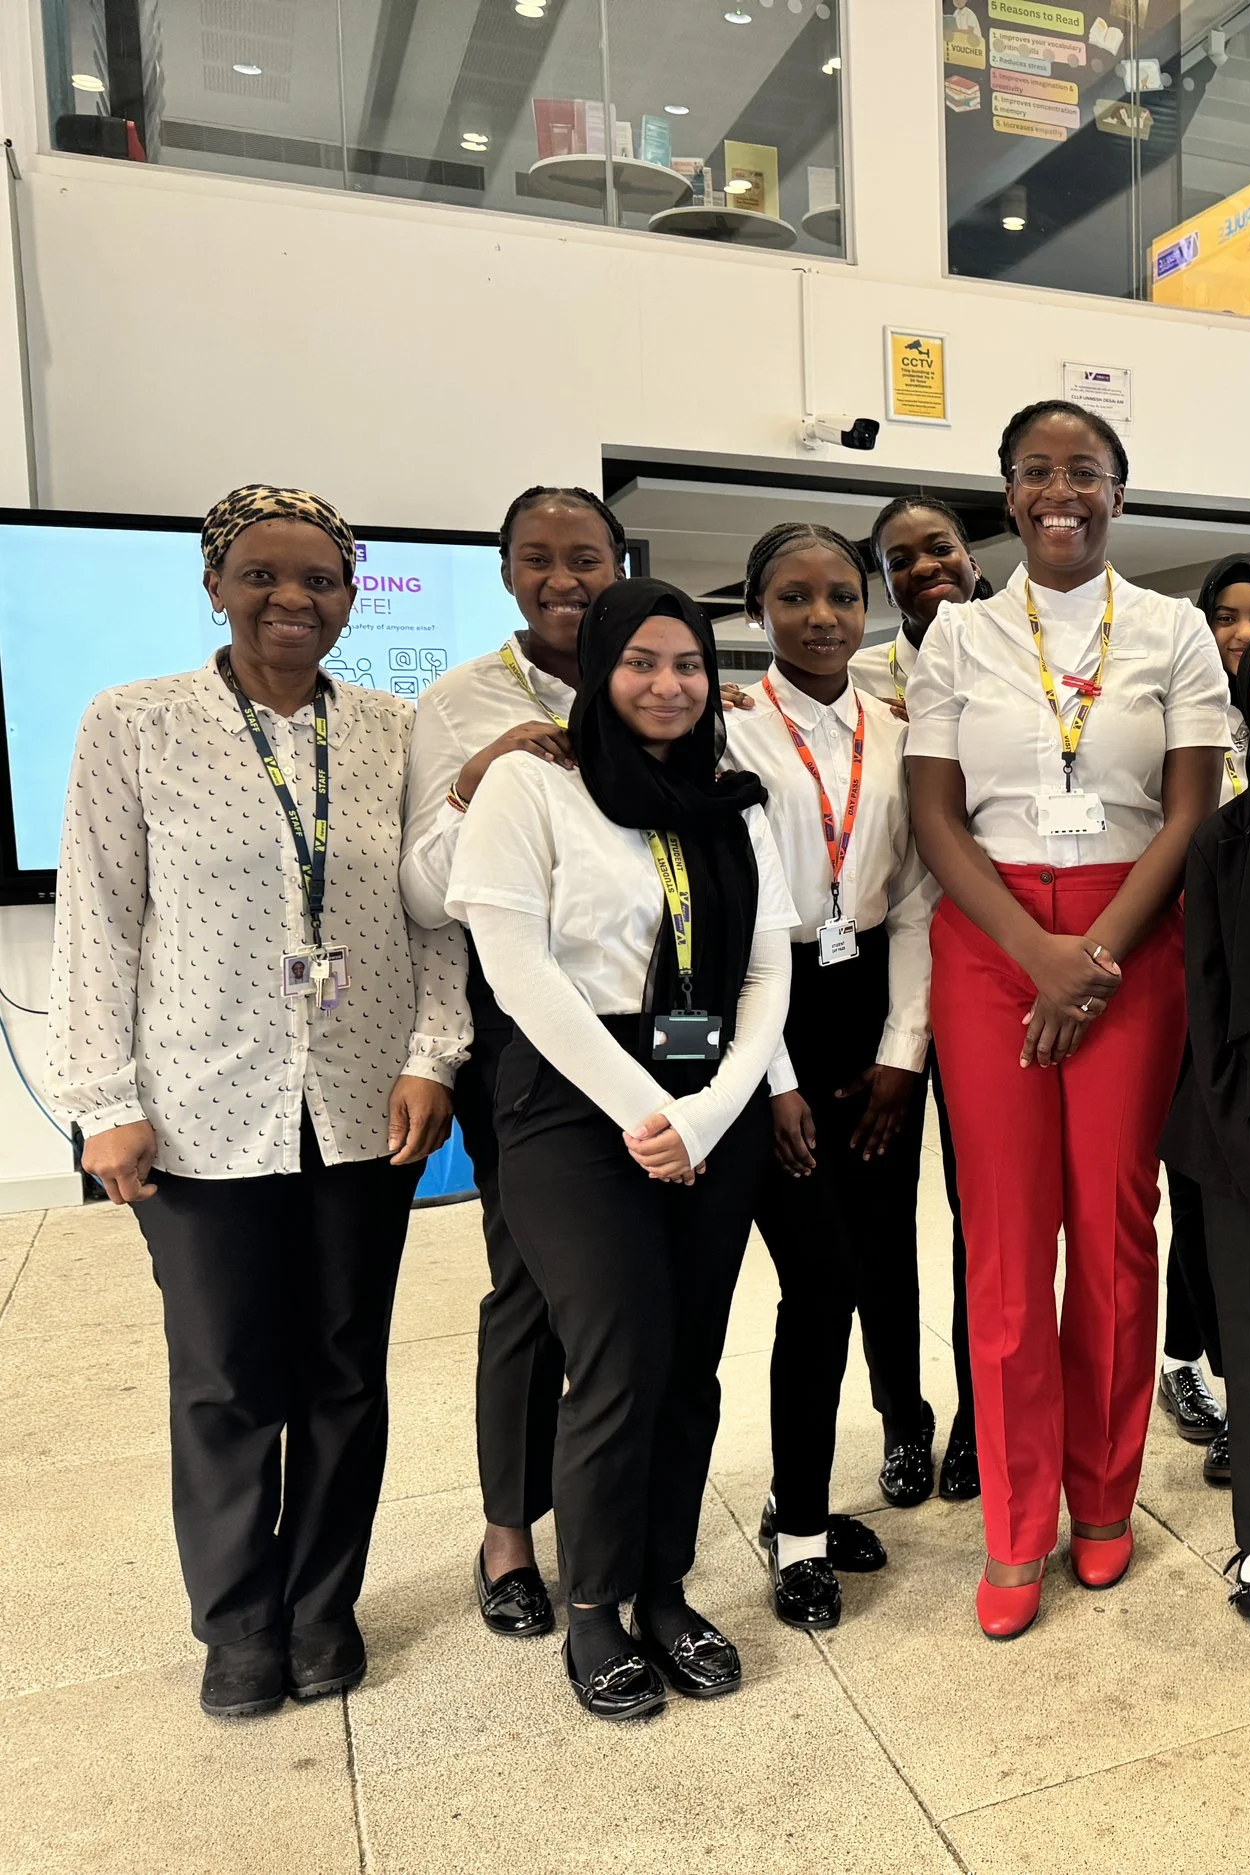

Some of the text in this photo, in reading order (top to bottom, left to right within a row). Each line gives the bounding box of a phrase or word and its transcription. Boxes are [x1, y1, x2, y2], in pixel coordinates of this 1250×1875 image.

[991, 1, 1080, 27] 5 Reasons to Read
[951, 43, 983, 56] VOUCHER
[1000, 33, 1031, 44] Improves
[1032, 38, 1047, 47] your
[1048, 41, 1082, 54] vocabulary
[1000, 56, 1027, 67] Reduces
[1028, 62, 1048, 72] stress
[999, 106, 1027, 117] memory
[1001, 96, 1031, 107] Improves
[1032, 103, 1078, 115] concentration
[1003, 121, 1034, 132] Increases
[1035, 127, 1063, 138] empathy
[901, 356, 933, 368] CCTV
[386, 624, 415, 632] anyone
[244, 707, 262, 733] STAFF
[318, 769, 327, 794] STAFF
[851, 778, 860, 799] PASS
[848, 799, 856, 816] DAY
[289, 810, 302, 837] STAFF
[670, 838, 684, 872] STUDENT
[657, 857, 675, 893] STUDENT
